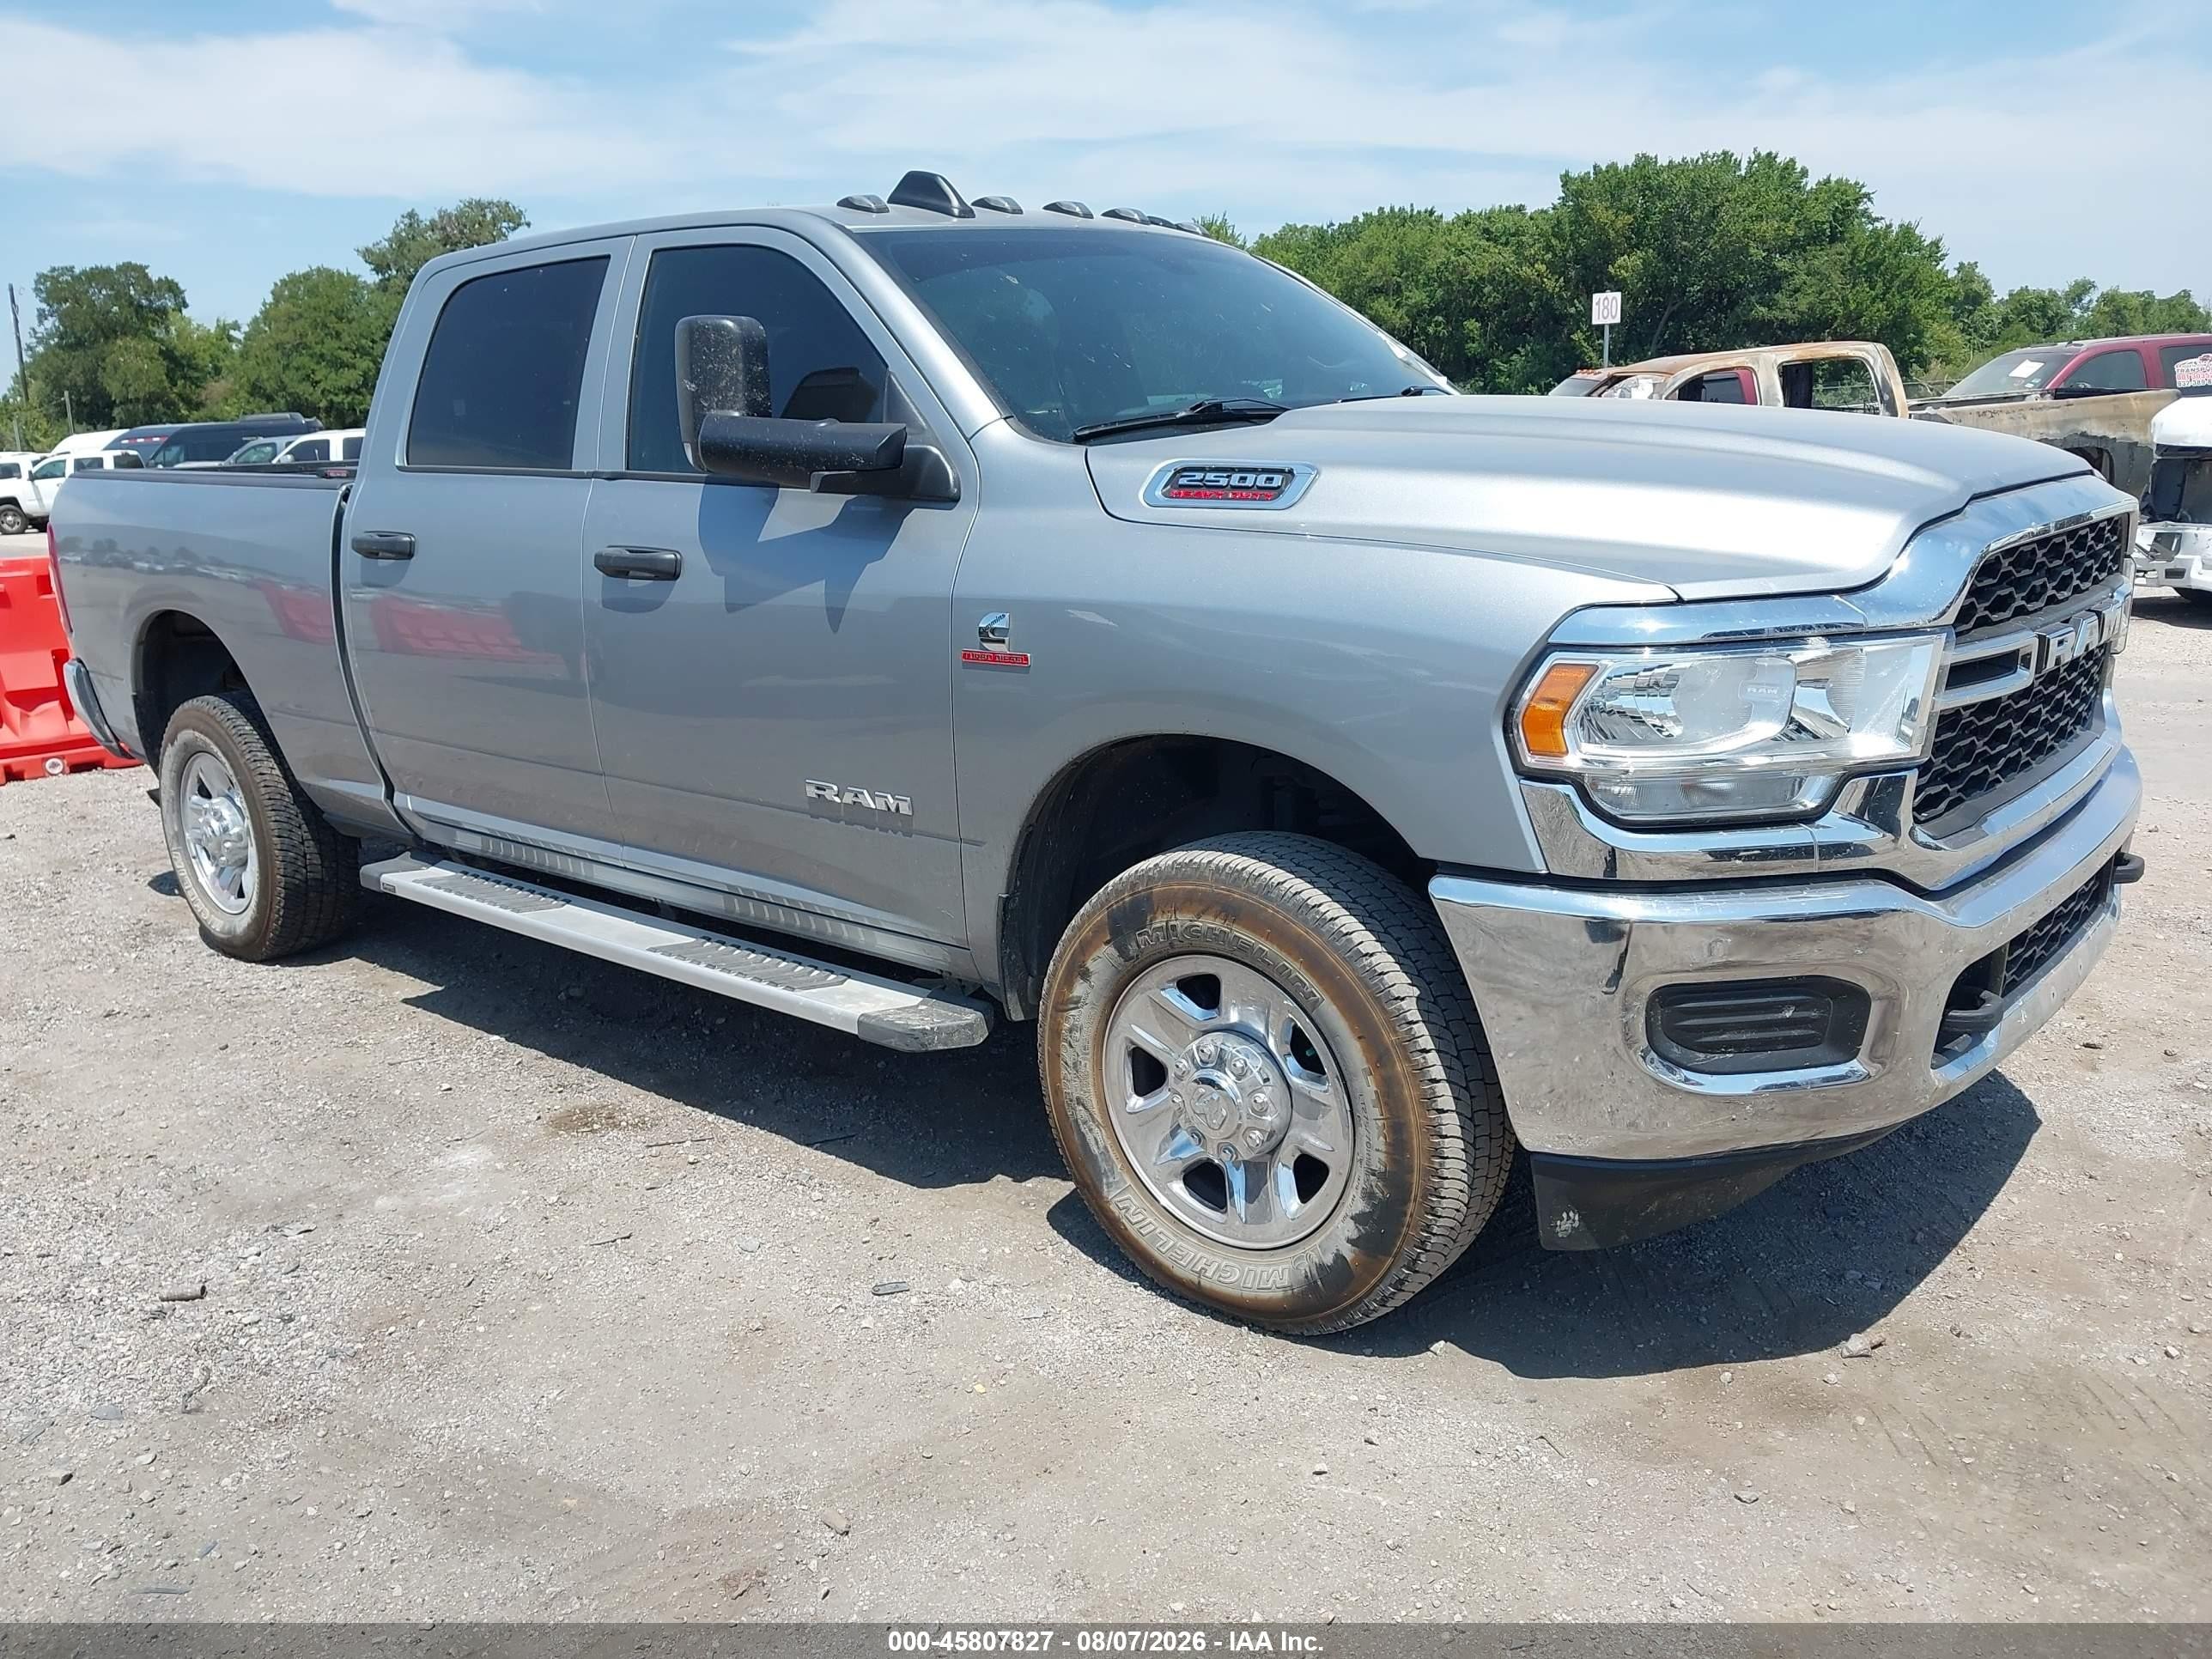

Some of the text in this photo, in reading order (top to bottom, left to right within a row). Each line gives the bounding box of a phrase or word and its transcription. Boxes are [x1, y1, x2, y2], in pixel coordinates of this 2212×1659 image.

[1595, 295, 1618, 319] 180
[1177, 472, 1283, 489] 2500
[2034, 600, 2124, 673] RAM
[805, 779, 914, 817] RAM
[1135, 921, 1321, 1003] MICHELIN
[1115, 1194, 1290, 1290] MICHELIN
